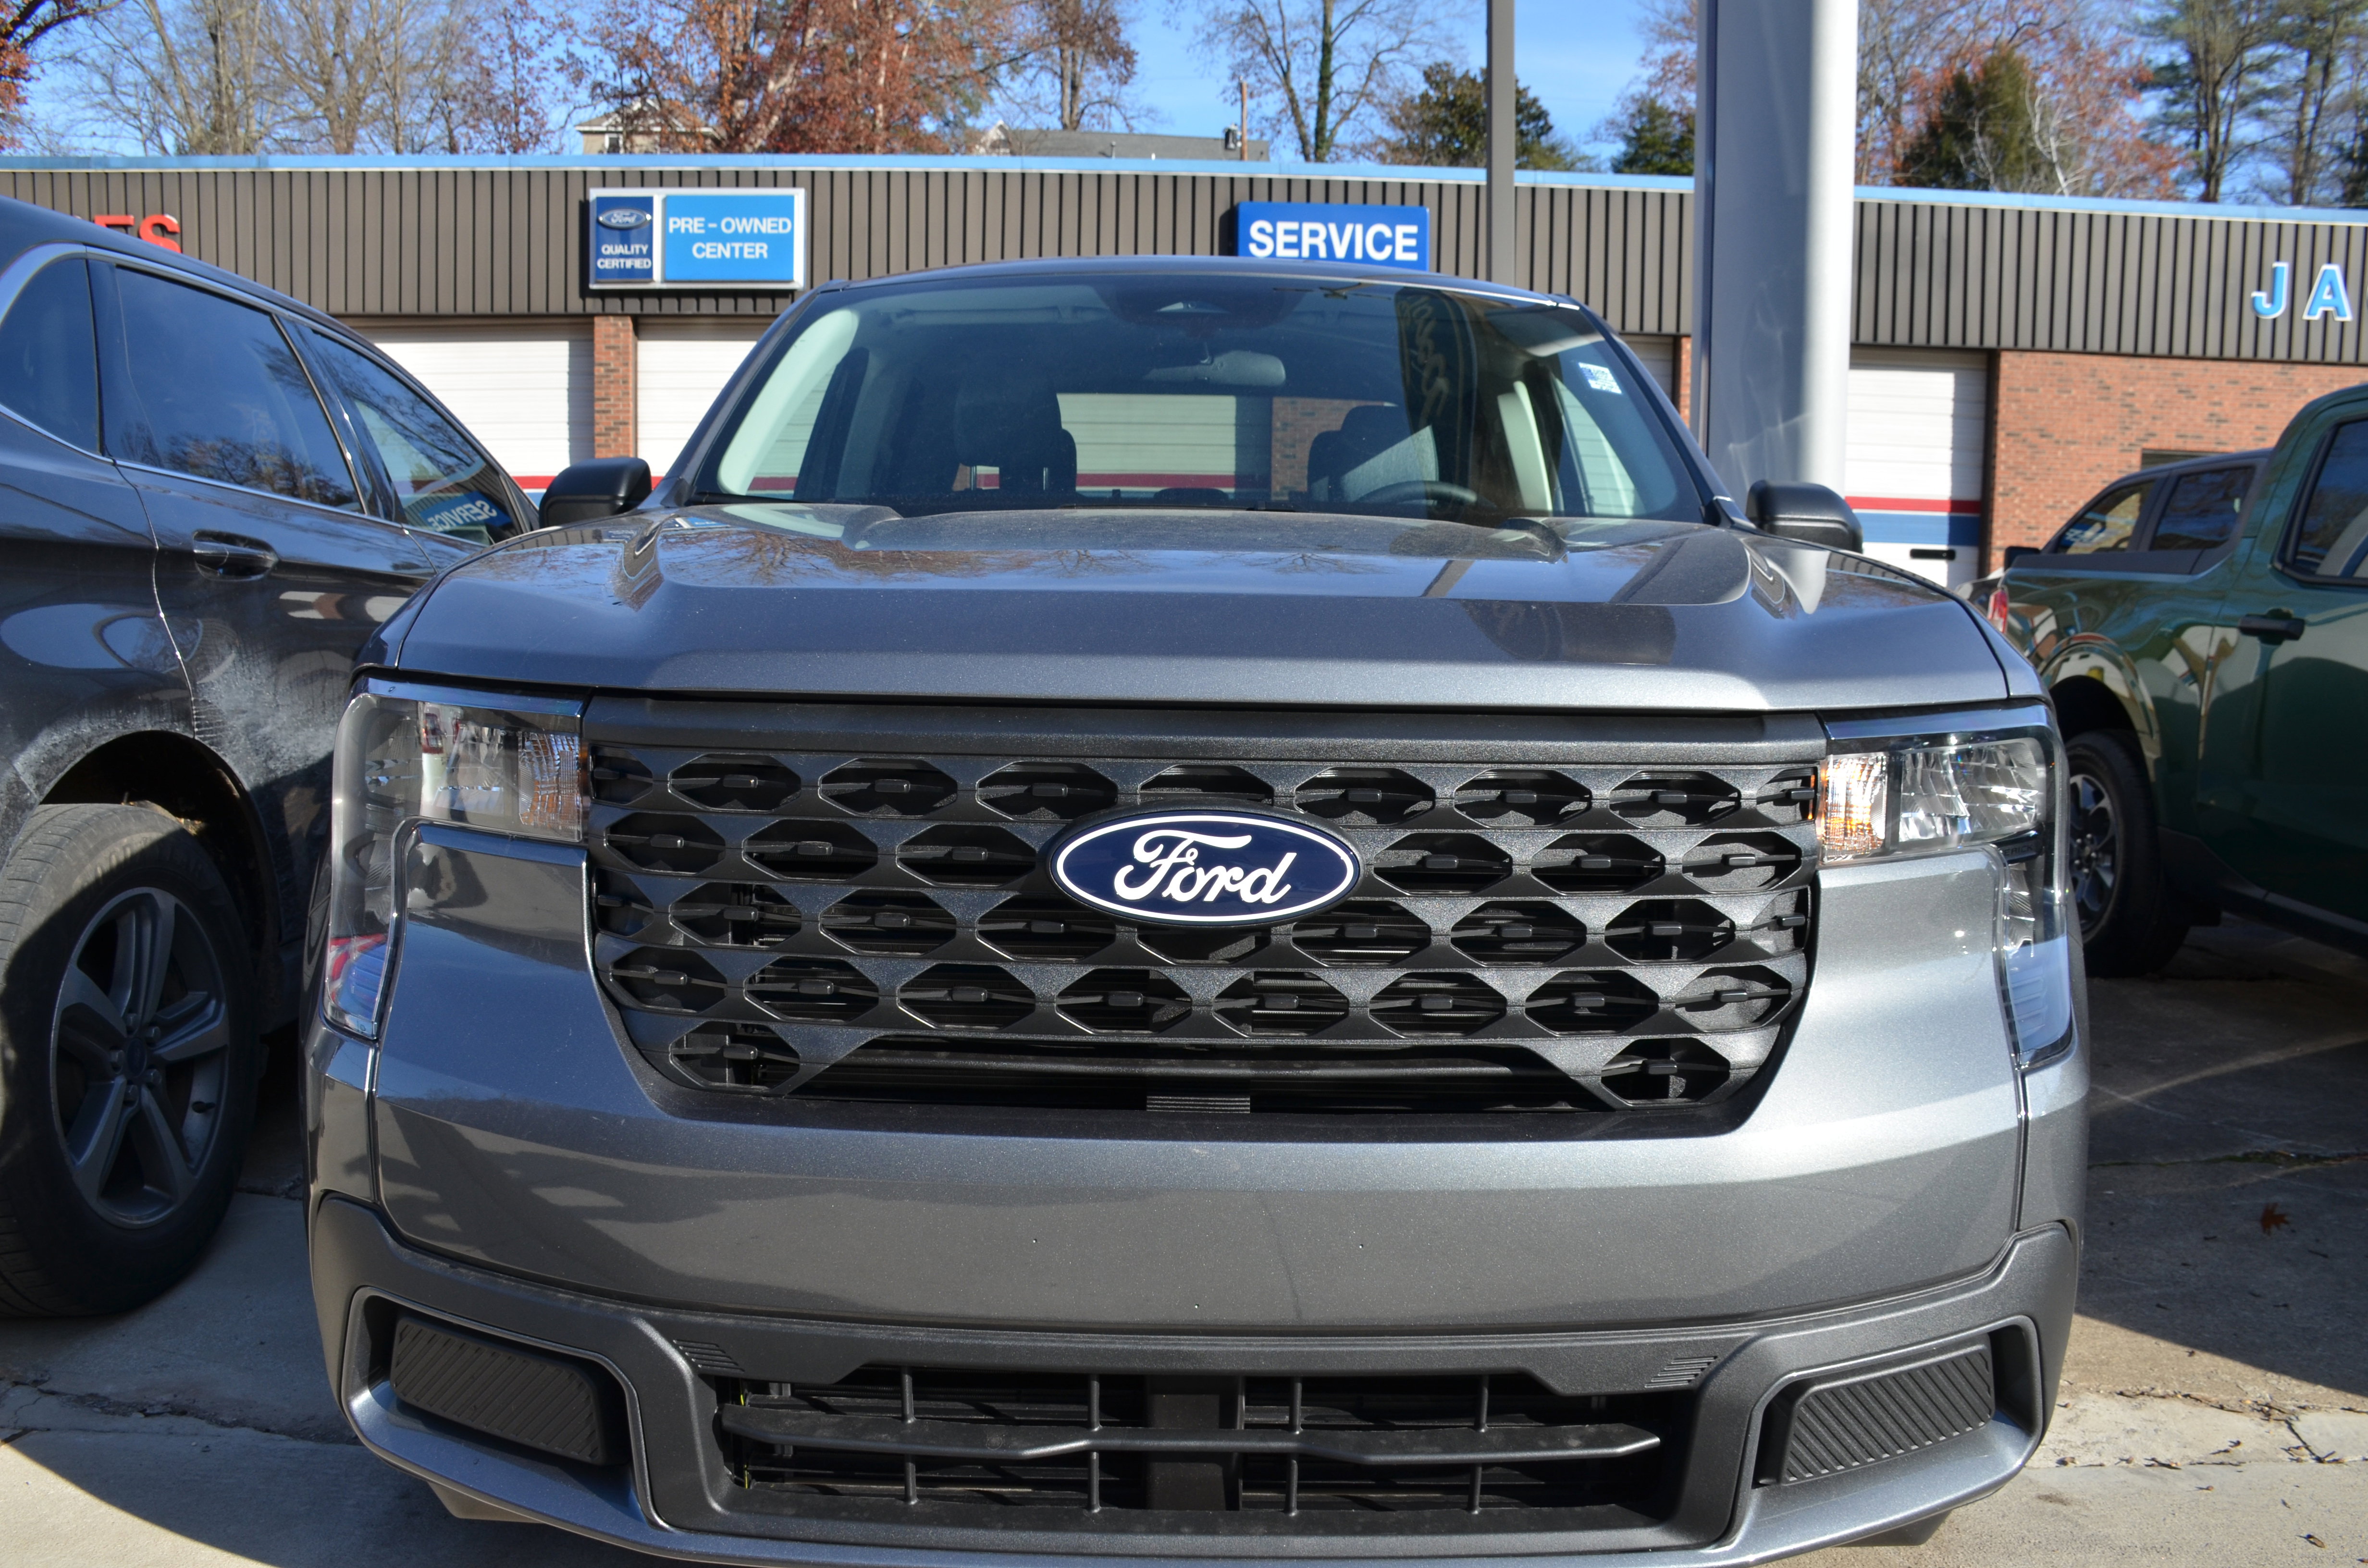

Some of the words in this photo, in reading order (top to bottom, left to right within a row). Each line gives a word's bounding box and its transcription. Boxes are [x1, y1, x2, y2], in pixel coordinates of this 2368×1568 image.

[601, 244, 649, 255] QUALITY
[692, 242, 768, 259] CENTER
[1248, 220, 1418, 261] SERVICE
[596, 257, 652, 269] CERTIFIED
[2251, 261, 2368, 321] JA
[1113, 829, 1297, 904] Ford
